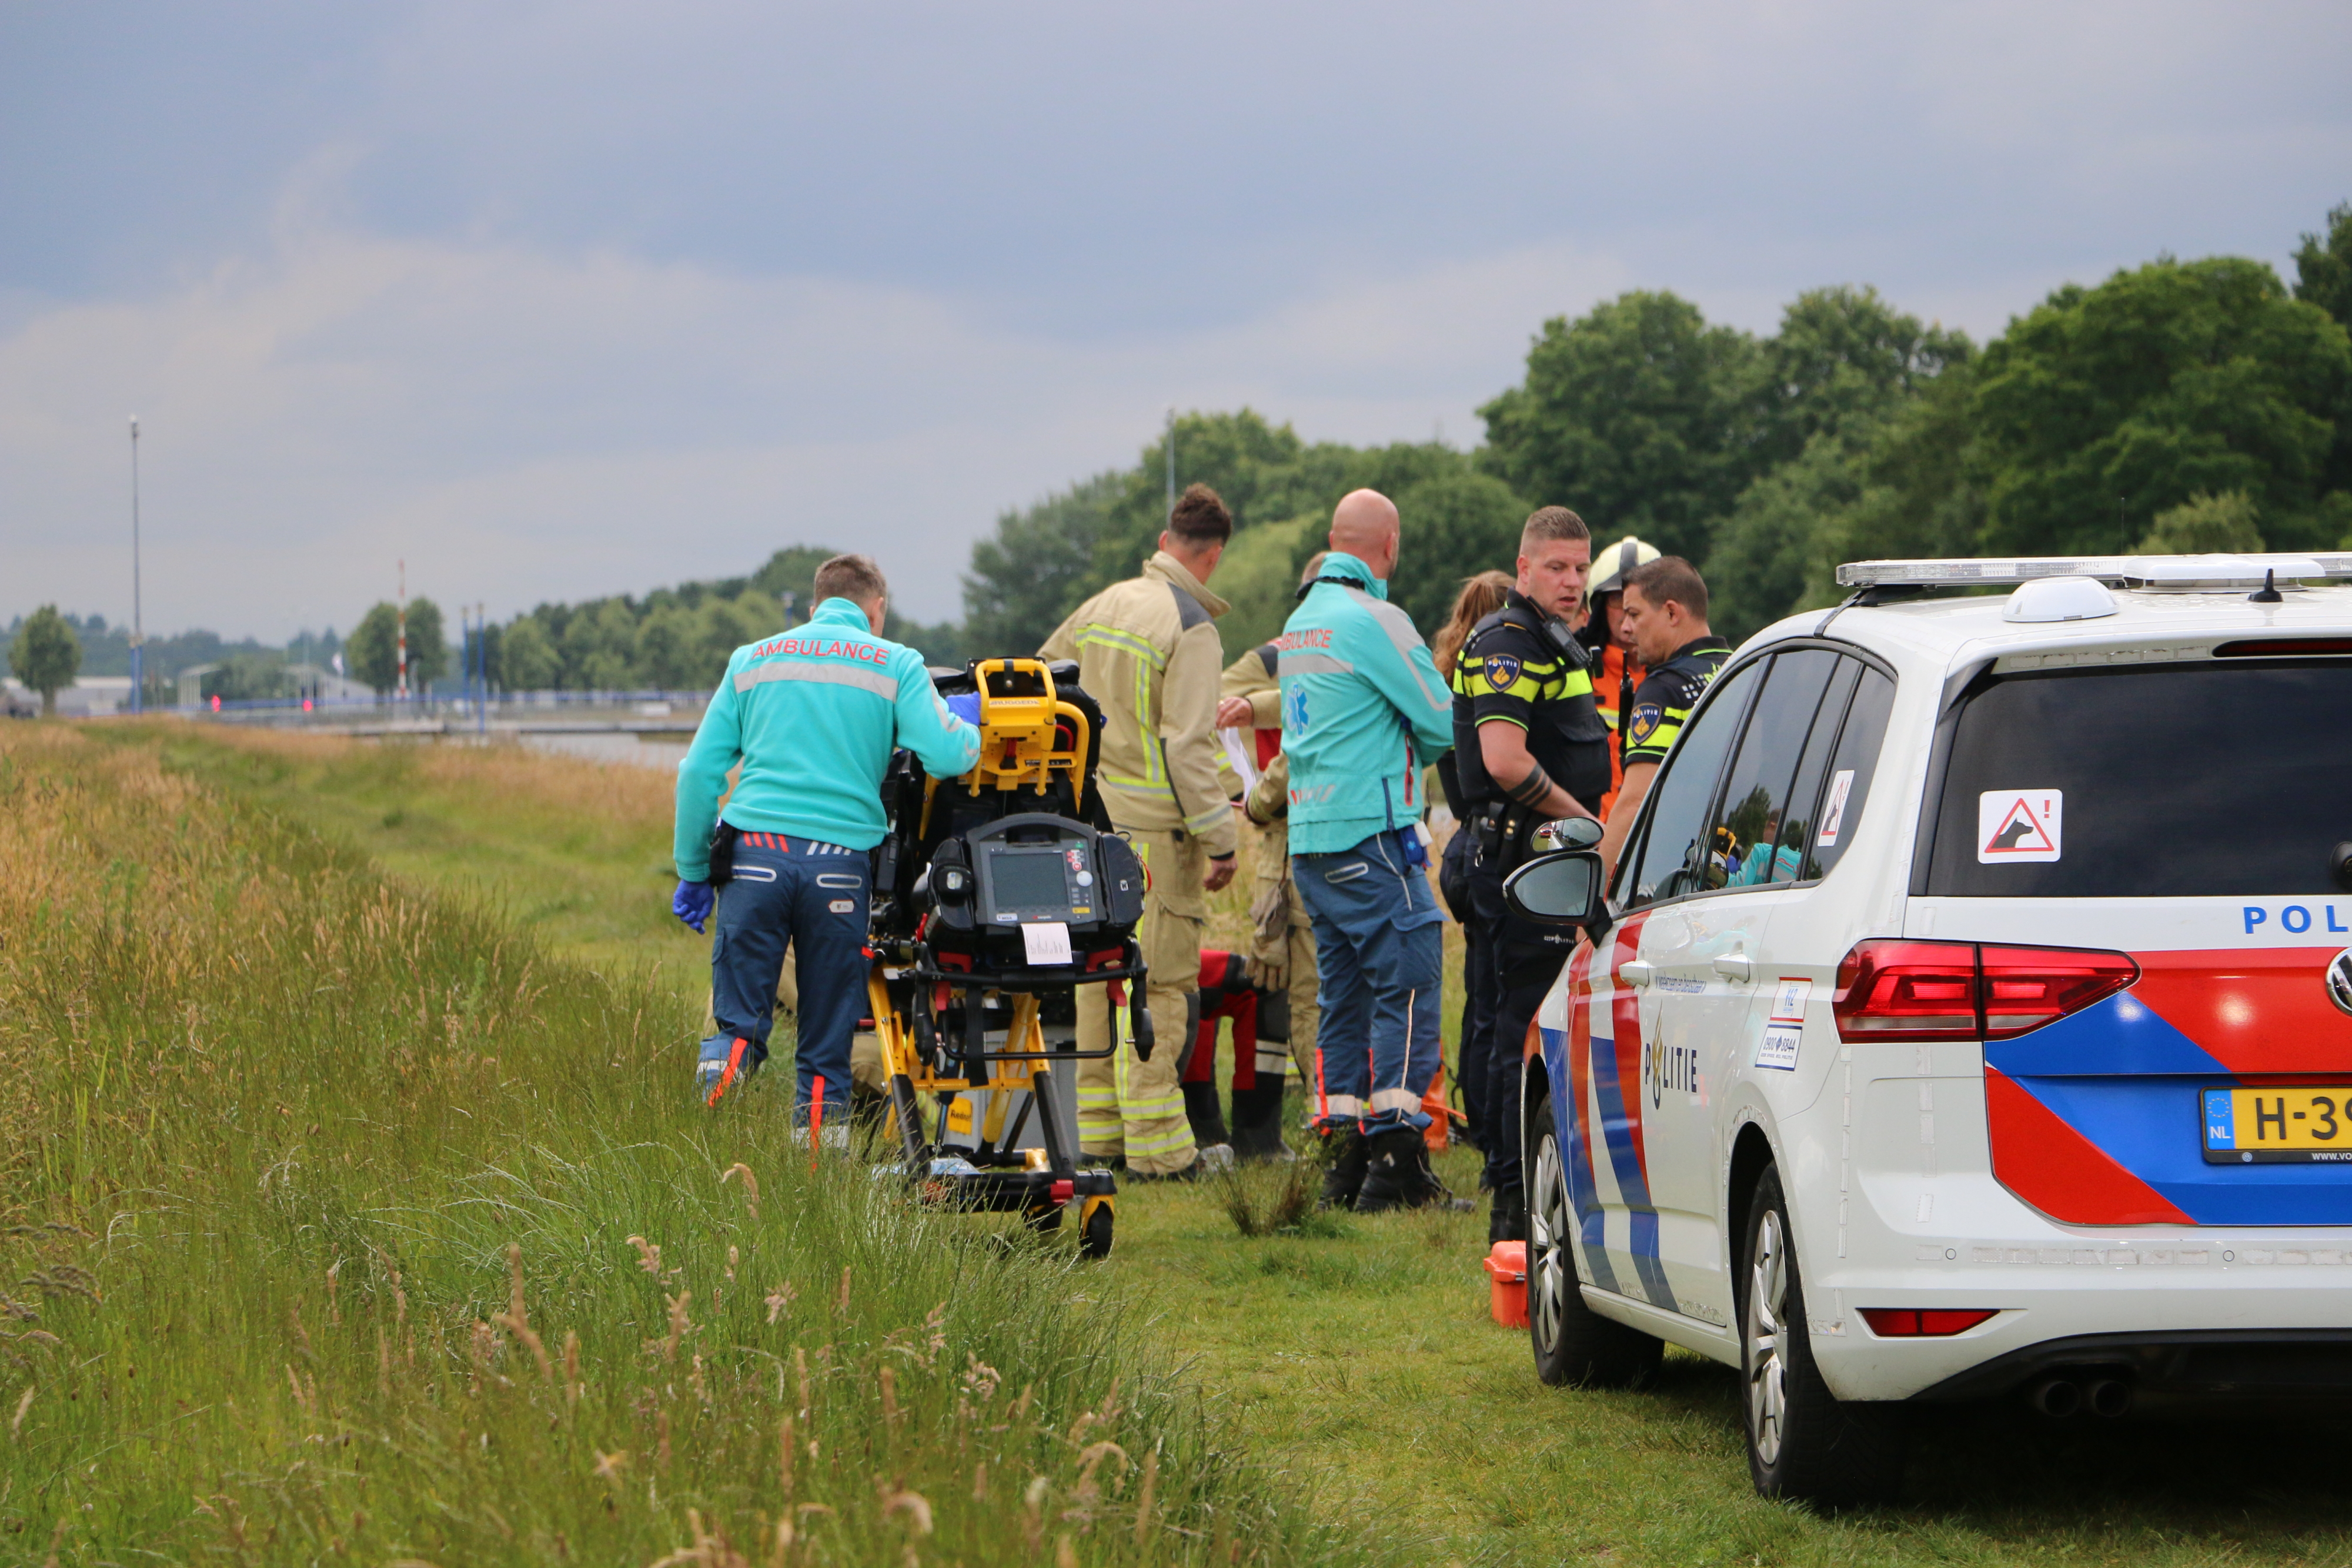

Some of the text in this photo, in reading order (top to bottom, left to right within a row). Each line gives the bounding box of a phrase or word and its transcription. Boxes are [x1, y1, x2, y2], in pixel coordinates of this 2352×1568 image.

[751, 639, 890, 666] AMBULANCE
[1488, 659, 1518, 667] POLITIE
[1785, 988, 1798, 1007] 112
[1763, 1037, 1796, 1053] 0900 8844
[1645, 1043, 1697, 1110] POLITIE
[2210, 1126, 2231, 1139] NL
[2311, 1152, 2352, 1161] WWW.VO
